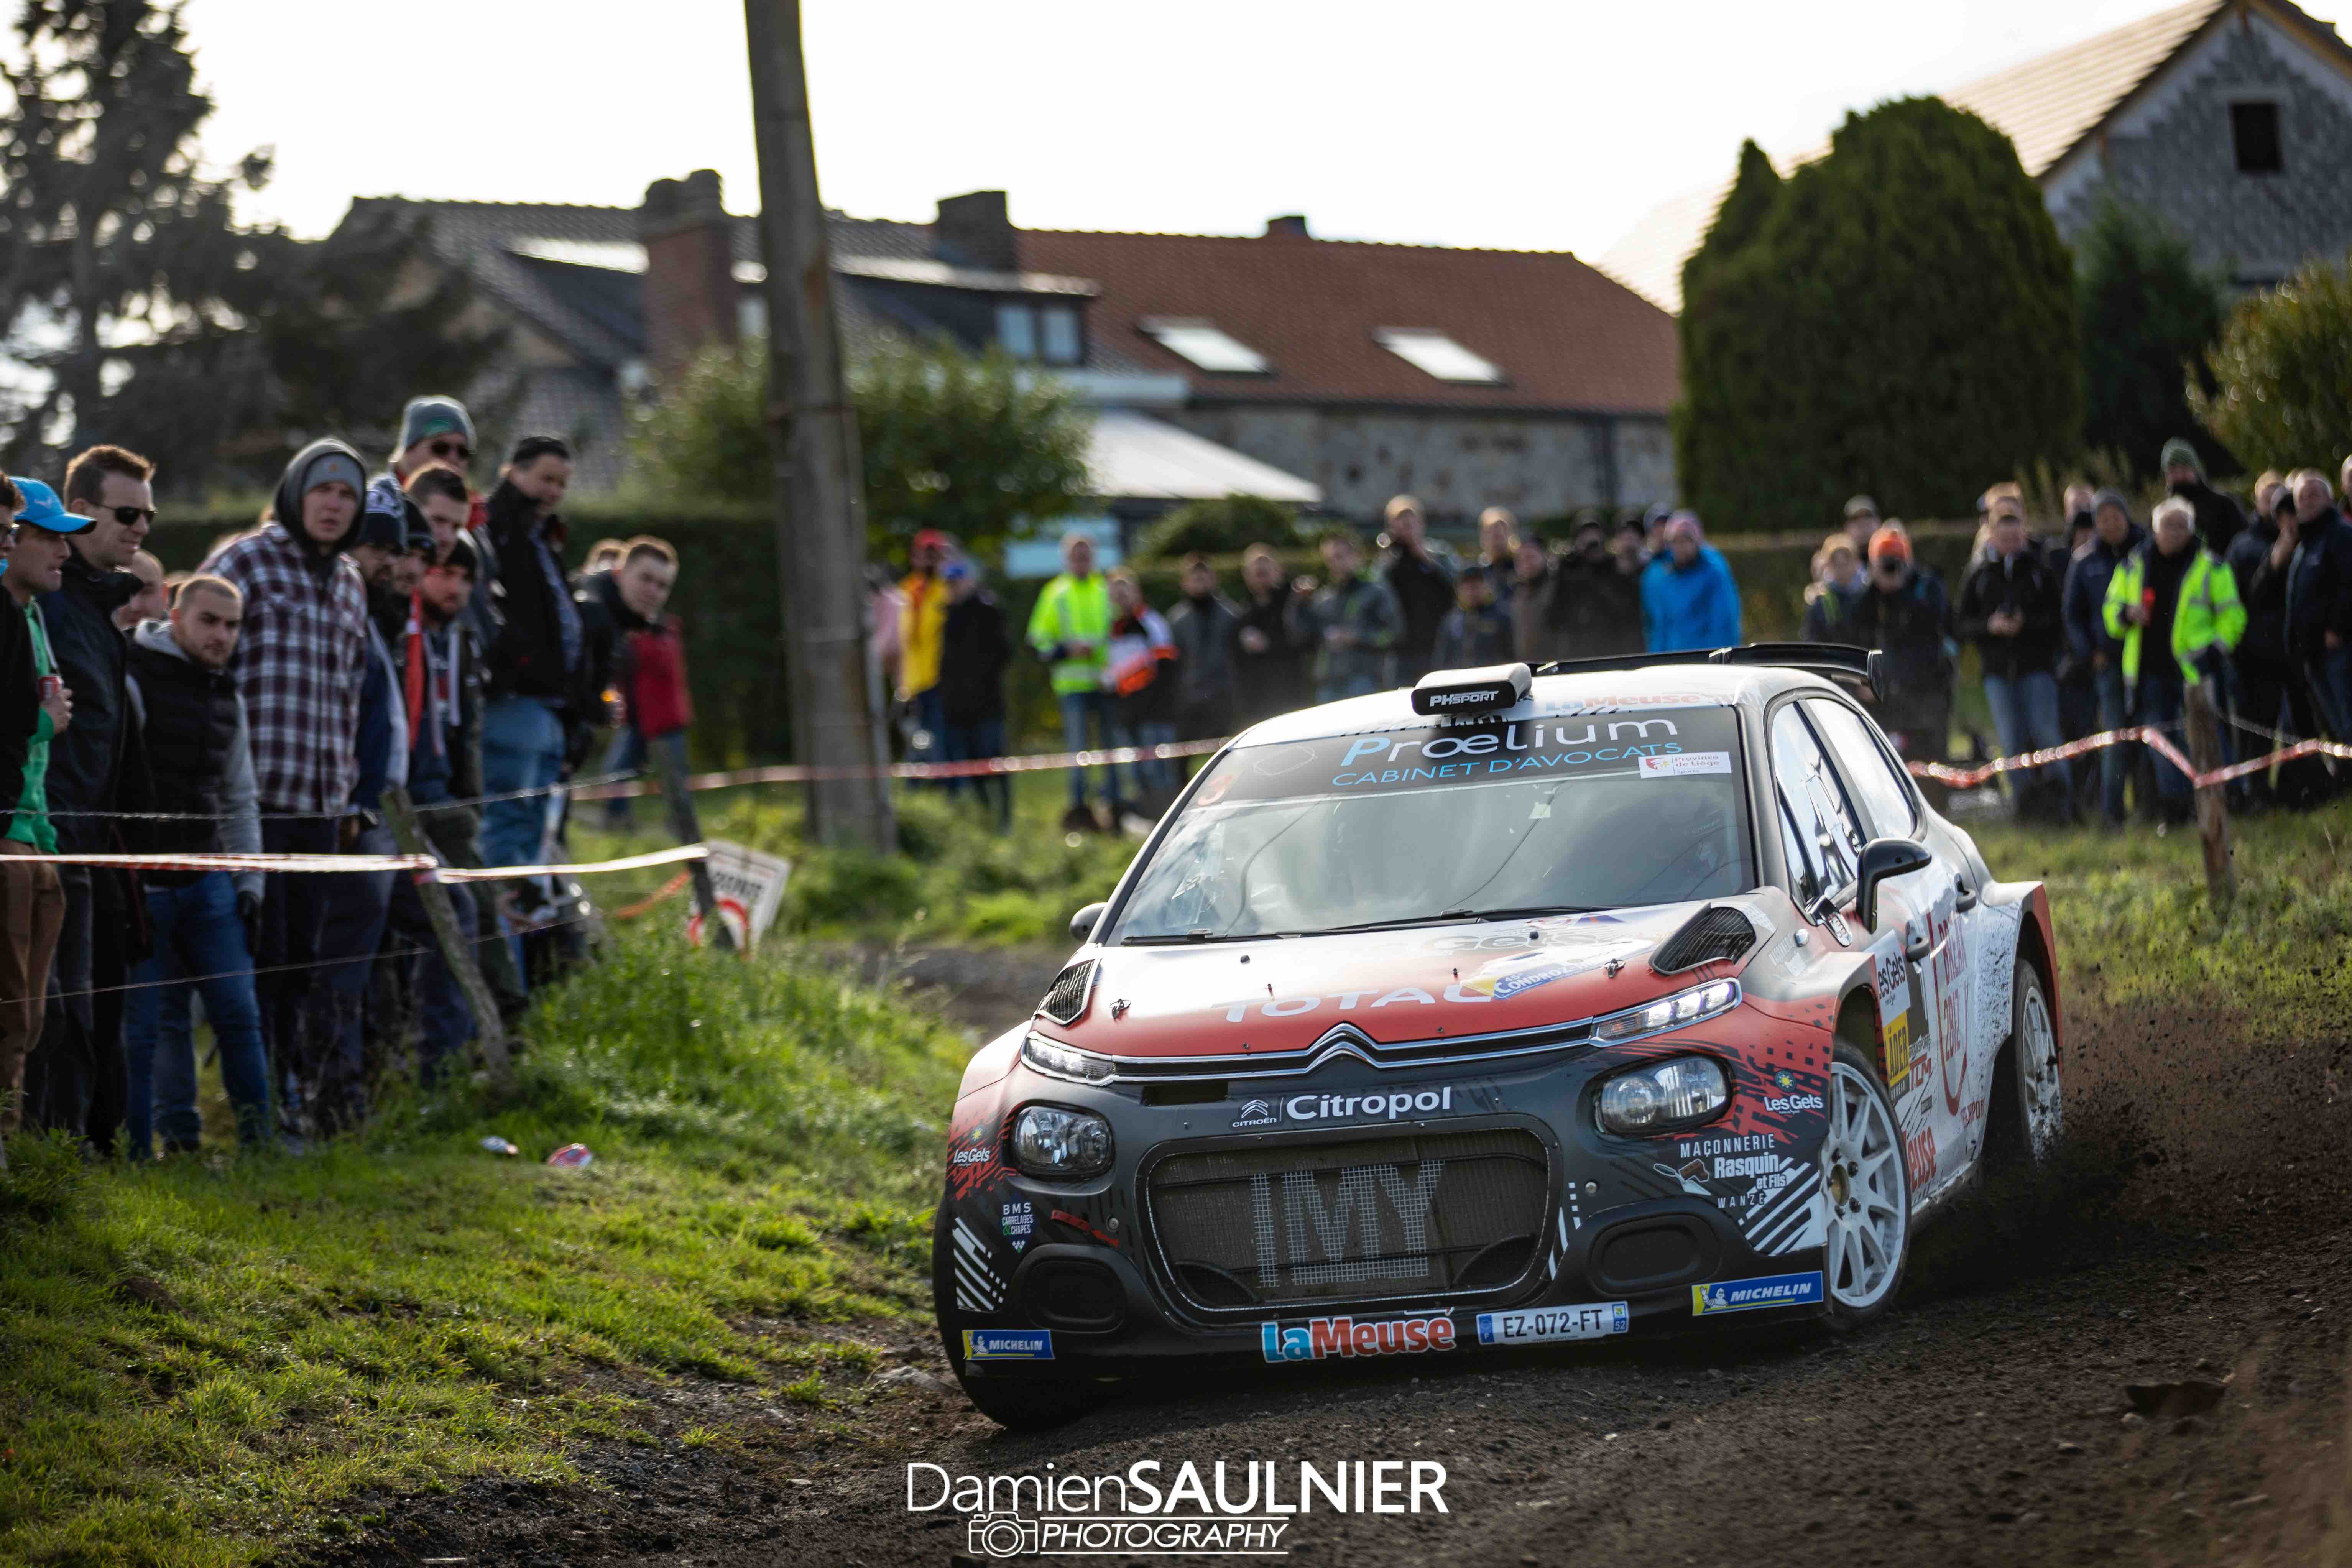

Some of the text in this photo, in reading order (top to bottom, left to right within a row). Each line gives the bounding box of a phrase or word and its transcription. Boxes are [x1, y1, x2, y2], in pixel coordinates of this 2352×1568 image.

[1331, 742, 1682, 786] CABINET D'AVOCATS
[1211, 984, 1491, 1022] TOTAL
[1286, 1086, 1451, 1120] Citropol
[1680, 1133, 1776, 1158] MAÇONNERIE
[1714, 1151, 1780, 1178] Rasquin
[1756, 1172, 1787, 1189] et Fils
[1718, 1193, 1764, 1209] WANZE
[1002, 1214, 1034, 1226] CARRELAGES
[1730, 1282, 1812, 1302] MICHELIN
[1502, 1309, 1602, 1338] EZ-072-FT
[1614, 1320, 1626, 1330] 52
[989, 1340, 1043, 1351] MICHELIN
[1261, 1316, 1456, 1363] LaMeuse
